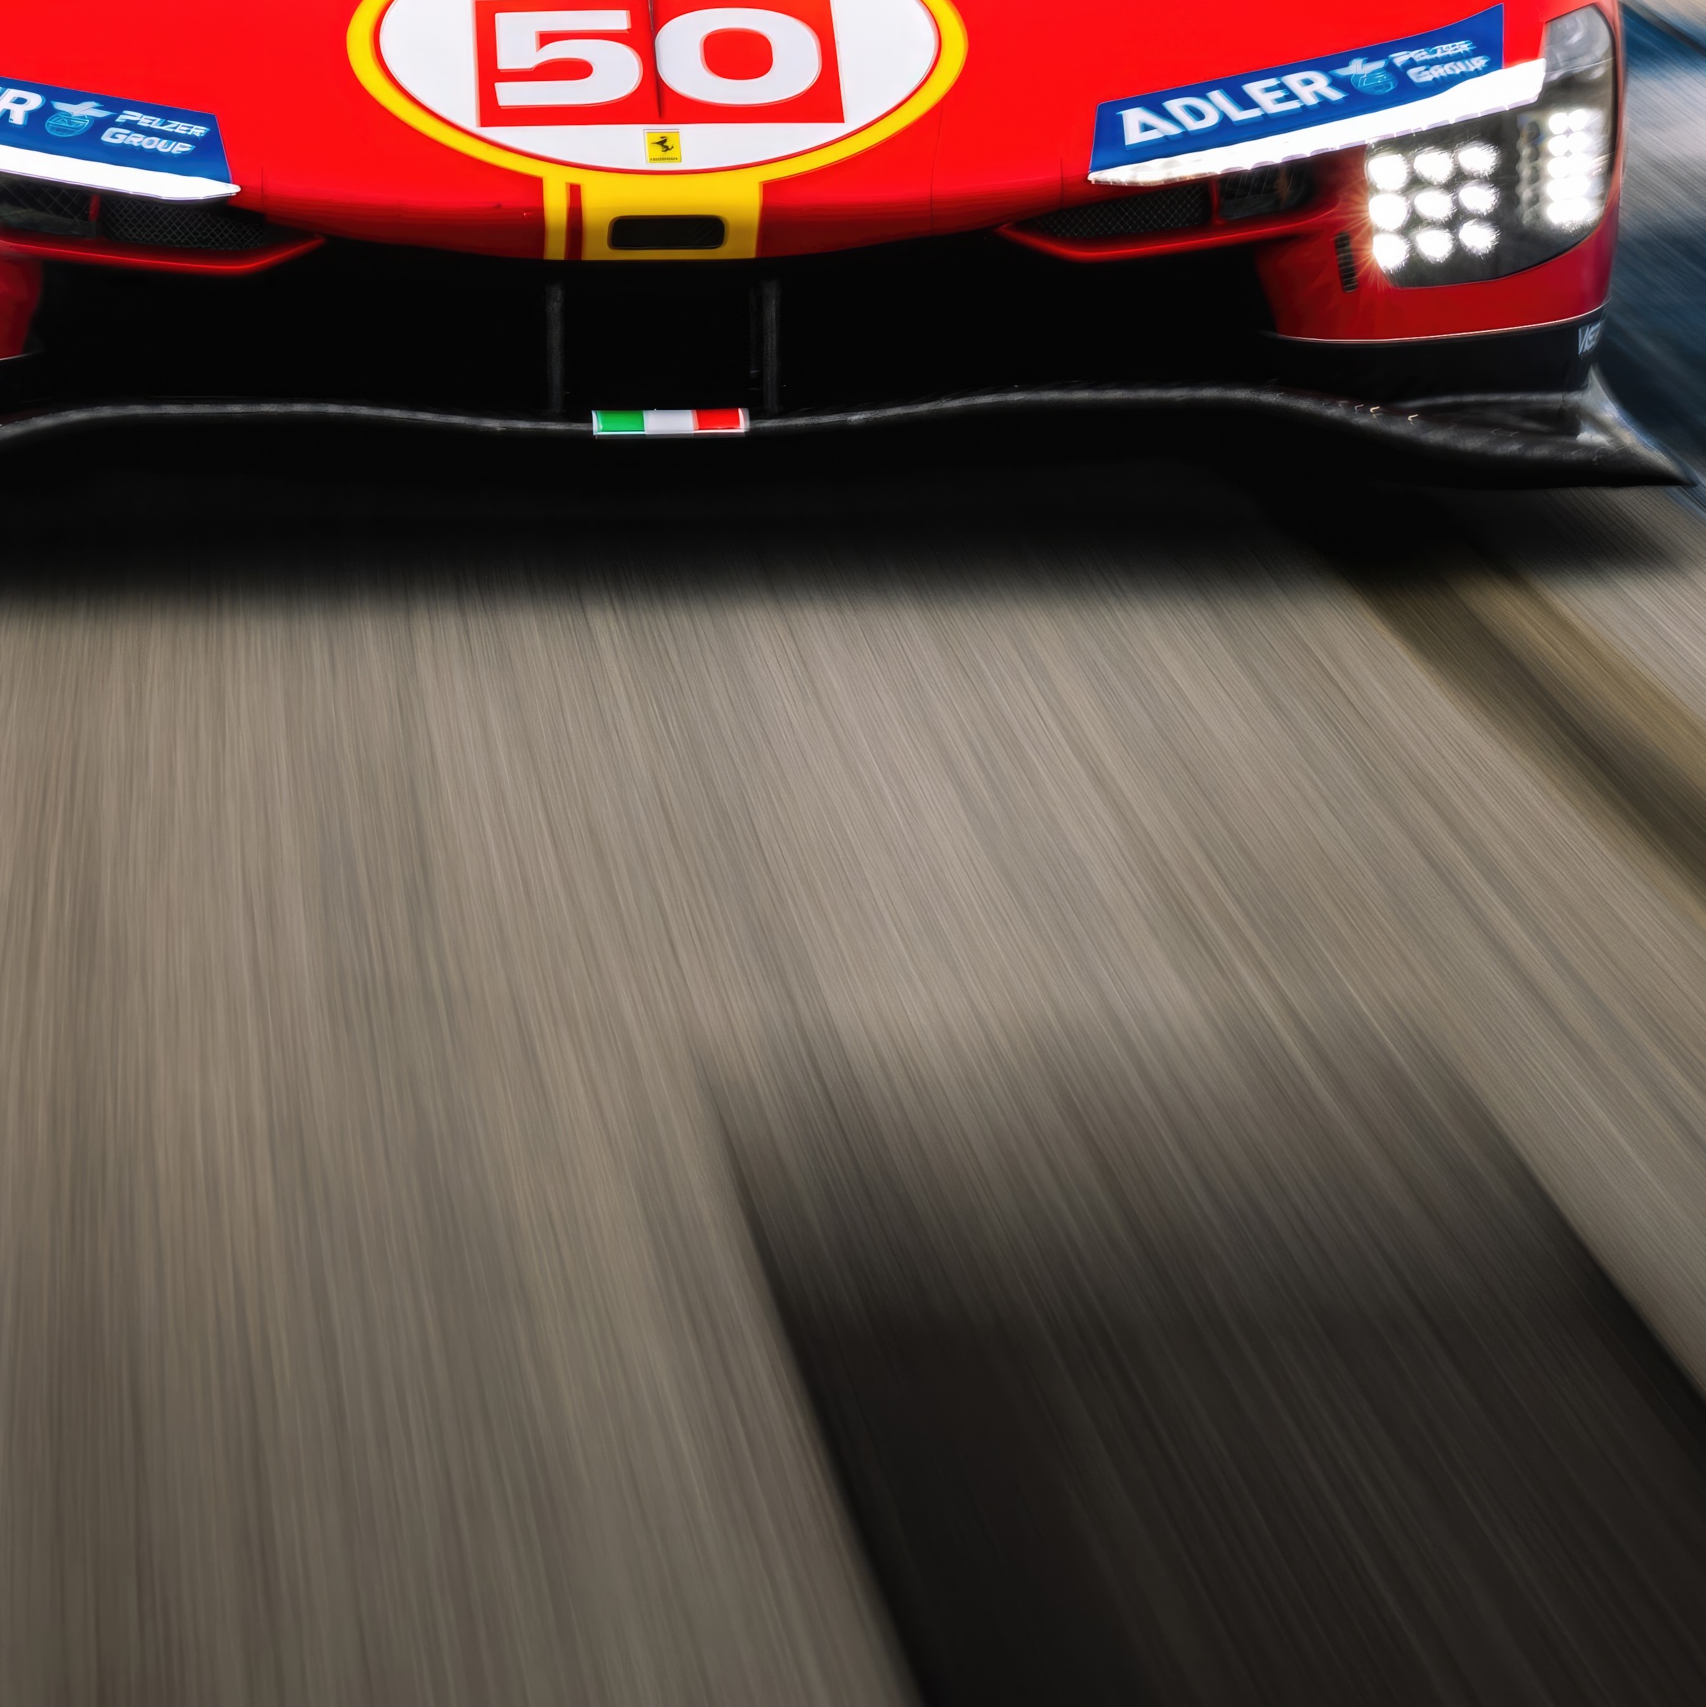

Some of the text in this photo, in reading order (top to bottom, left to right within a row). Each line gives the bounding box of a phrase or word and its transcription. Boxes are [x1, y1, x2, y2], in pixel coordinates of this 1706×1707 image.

[494, 7, 821, 108] 50
[115, 110, 210, 137] PELZER
[1116, 70, 1349, 148] ADLER
[100, 127, 196, 155] GROUP
